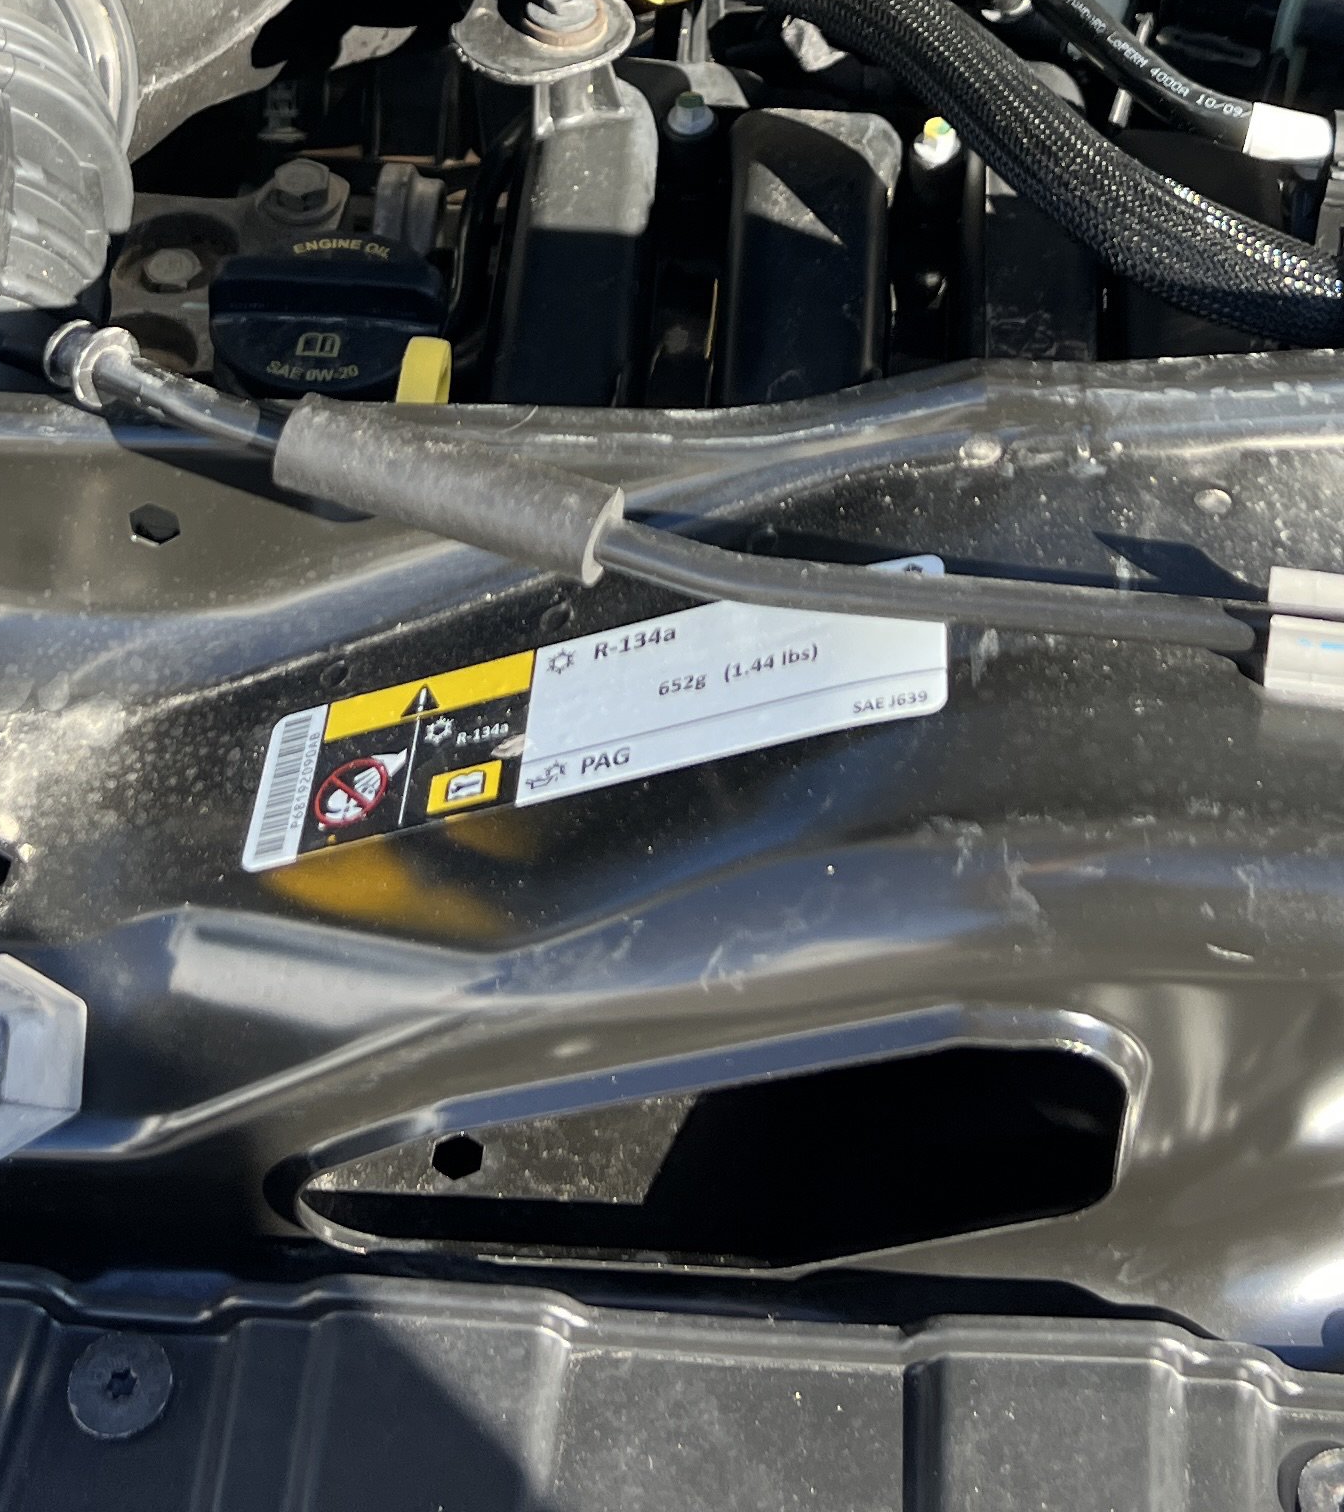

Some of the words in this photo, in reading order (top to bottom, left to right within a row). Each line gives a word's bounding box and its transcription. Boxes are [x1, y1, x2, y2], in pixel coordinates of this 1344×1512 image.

[1106, 31, 1150, 69] LoPERM
[292, 238, 362, 255] ENGINE
[364, 241, 392, 261] OIL
[266, 360, 302, 381] SAE
[306, 364, 360, 382] 0W-20
[592, 625, 677, 661] R-134a
[658, 671, 708, 697] 652g
[723, 654, 775, 683] (1.44
[781, 643, 819, 666] lbs)
[852, 696, 885, 714] SAE
[889, 689, 929, 709] J639
[453, 719, 512, 747] R-134a
[579, 746, 632, 775] PAG
